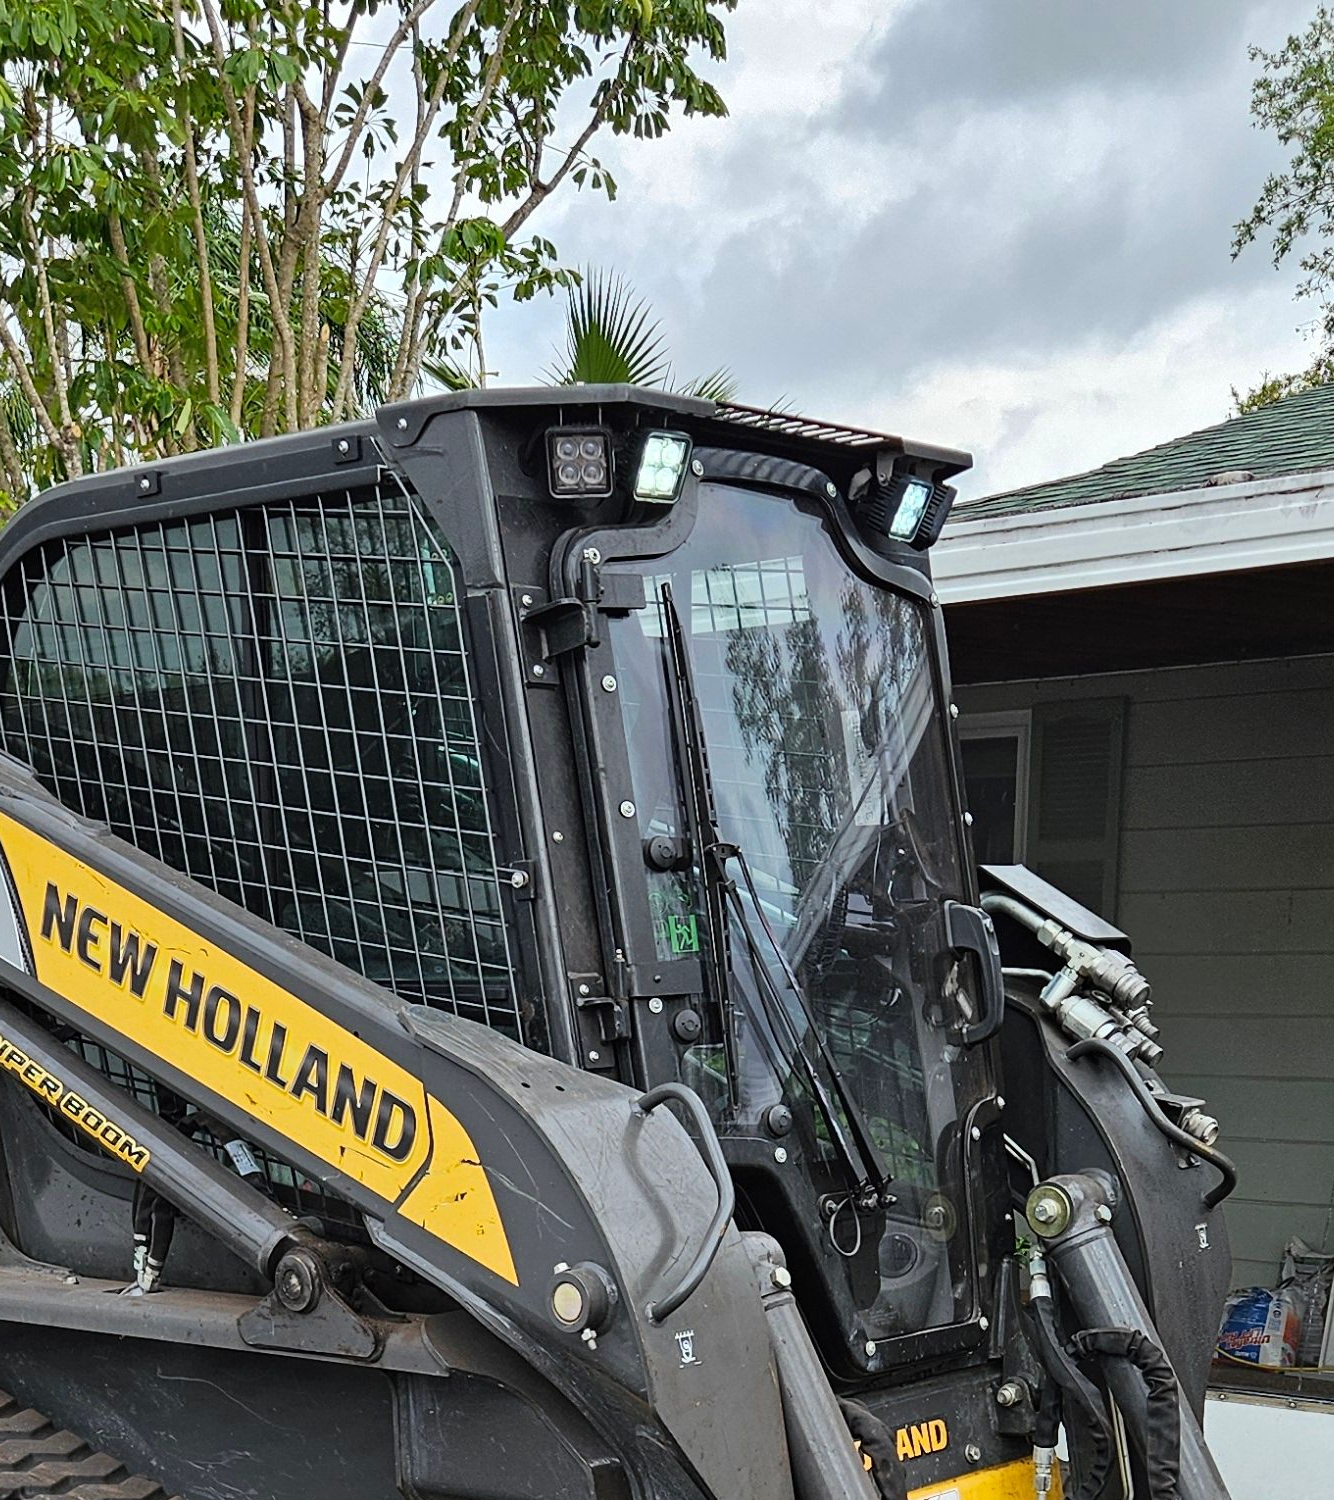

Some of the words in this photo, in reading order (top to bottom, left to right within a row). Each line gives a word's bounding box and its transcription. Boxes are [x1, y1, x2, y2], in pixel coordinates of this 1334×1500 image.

[39, 881, 158, 1000] NEW
[163, 957, 418, 1164] HOLLAND
[61, 1092, 150, 1171] BOOM
